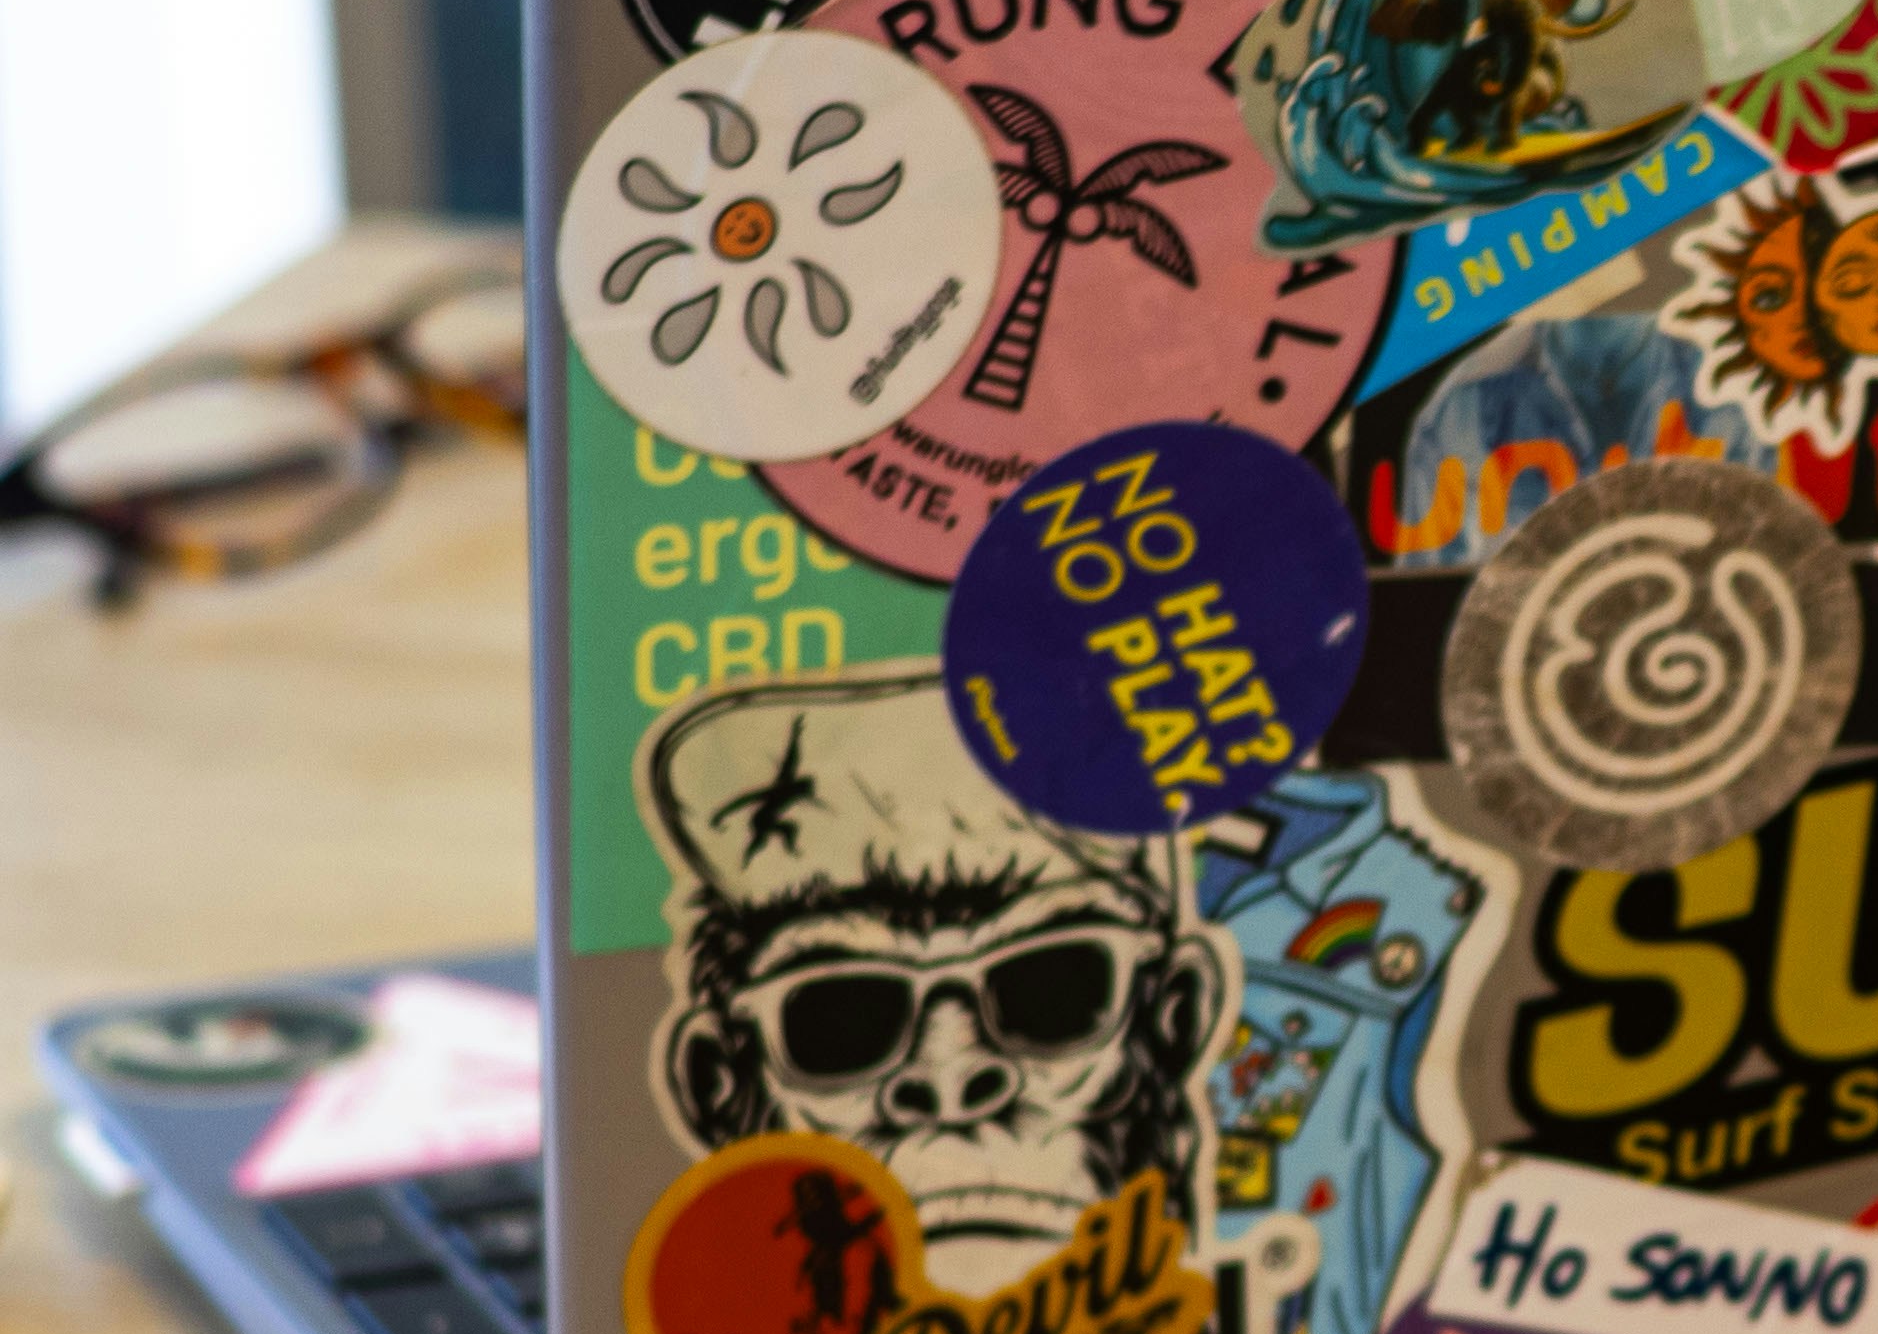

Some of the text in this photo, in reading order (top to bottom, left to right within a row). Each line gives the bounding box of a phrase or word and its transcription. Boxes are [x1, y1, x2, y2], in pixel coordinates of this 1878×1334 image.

[1415, 130, 1715, 322] CAMPING
[1024, 483, 1223, 812] NO PLAY.
[1096, 454, 1293, 769] NO HAT?
[1618, 1084, 1806, 1187] Surf
[1476, 1204, 1588, 1306] Ho
